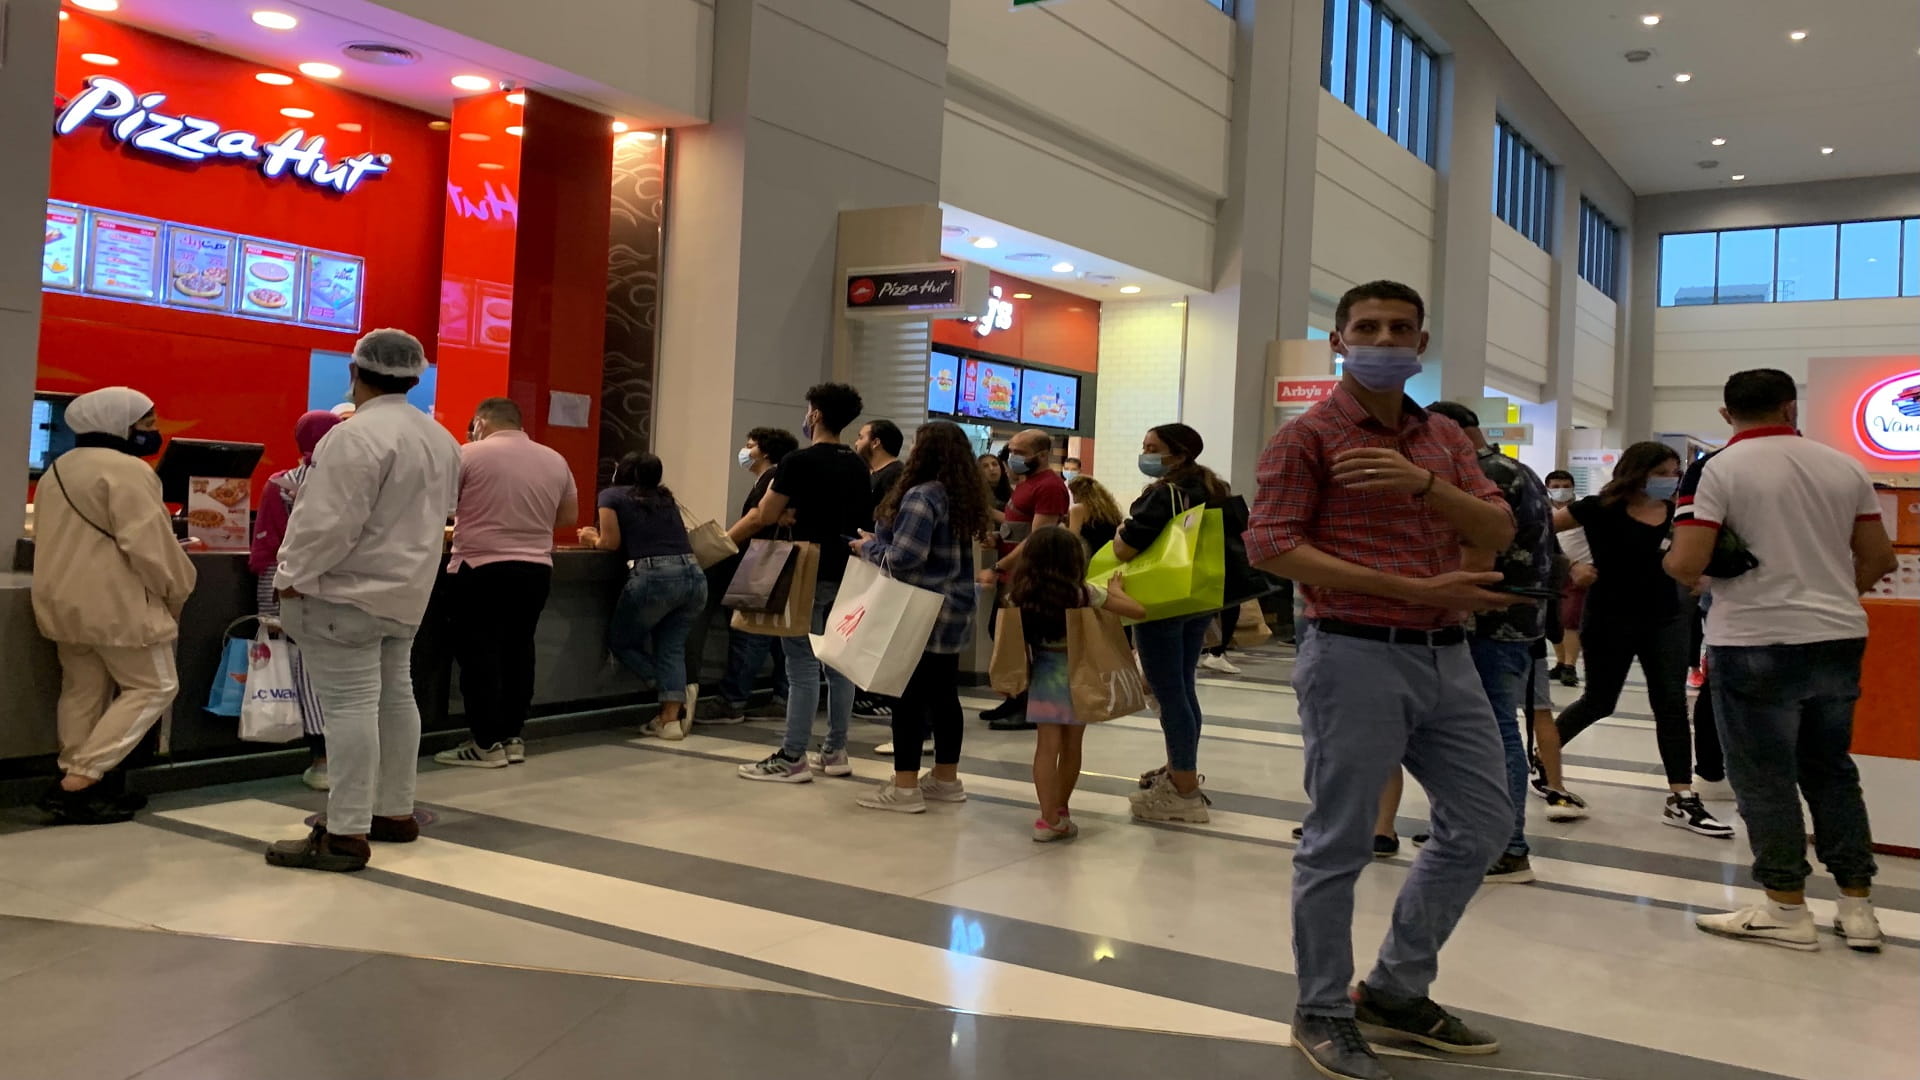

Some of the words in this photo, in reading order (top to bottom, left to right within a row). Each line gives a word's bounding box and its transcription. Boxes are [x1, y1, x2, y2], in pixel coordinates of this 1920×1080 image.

[56, 75, 259, 161] Pizza
[263, 128, 388, 193] Hut
[878, 281, 918, 299] Pizza
[919, 279, 949, 295] Hut
[1281, 384, 1322, 399] Arby's
